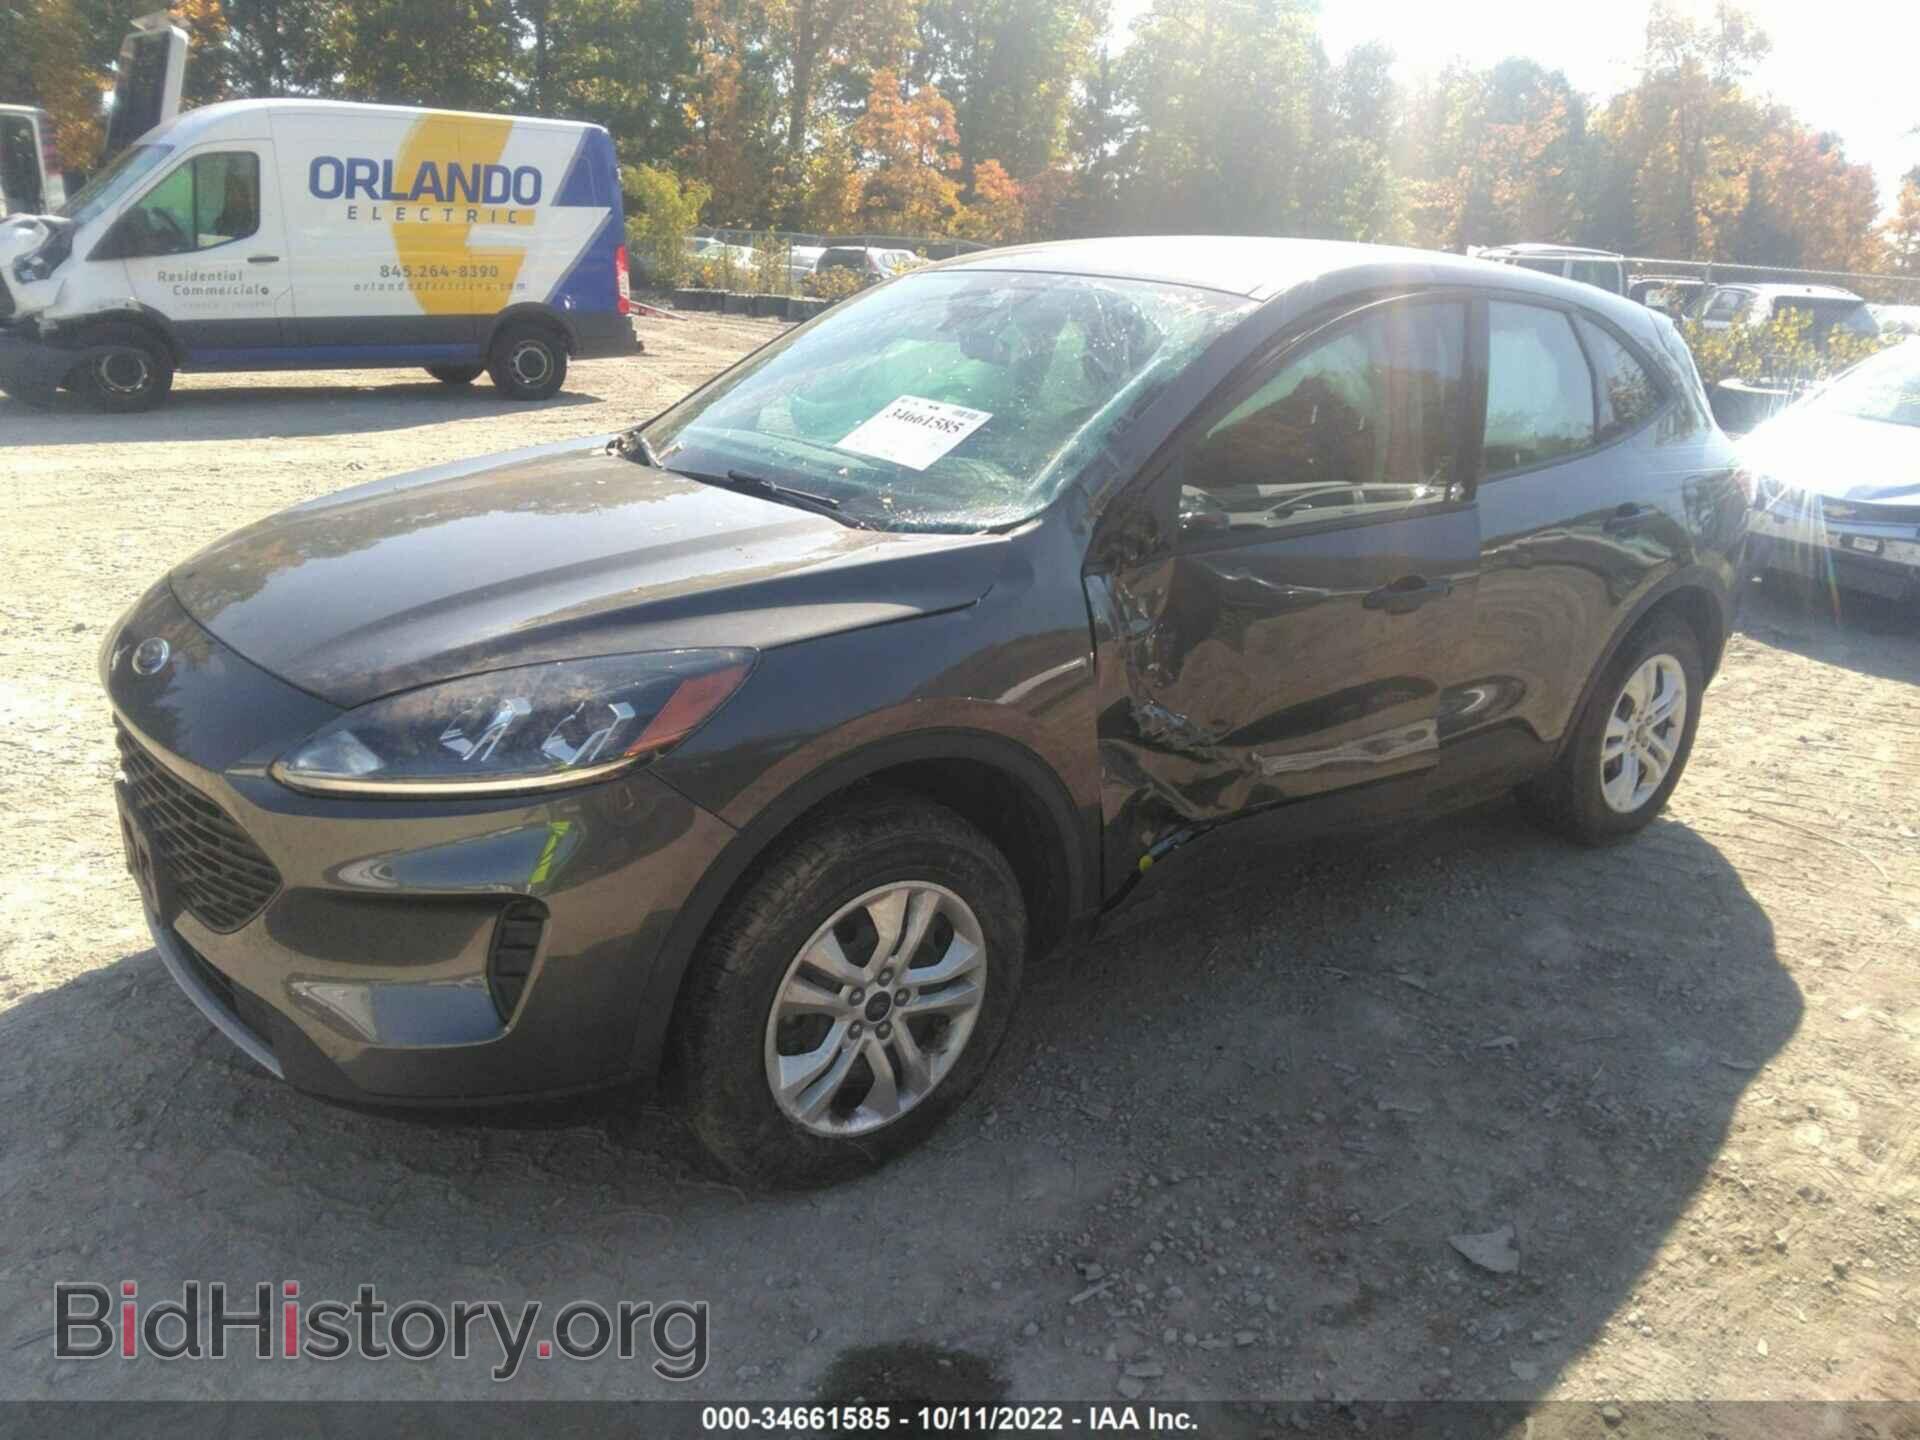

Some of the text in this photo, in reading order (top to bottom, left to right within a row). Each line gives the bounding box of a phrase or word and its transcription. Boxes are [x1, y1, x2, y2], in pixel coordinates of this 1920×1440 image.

[309, 156, 543, 206] ORLANDO
[347, 205, 518, 224] ELECTRIC
[157, 270, 244, 281] Residential
[379, 264, 500, 279] 845.264-8390
